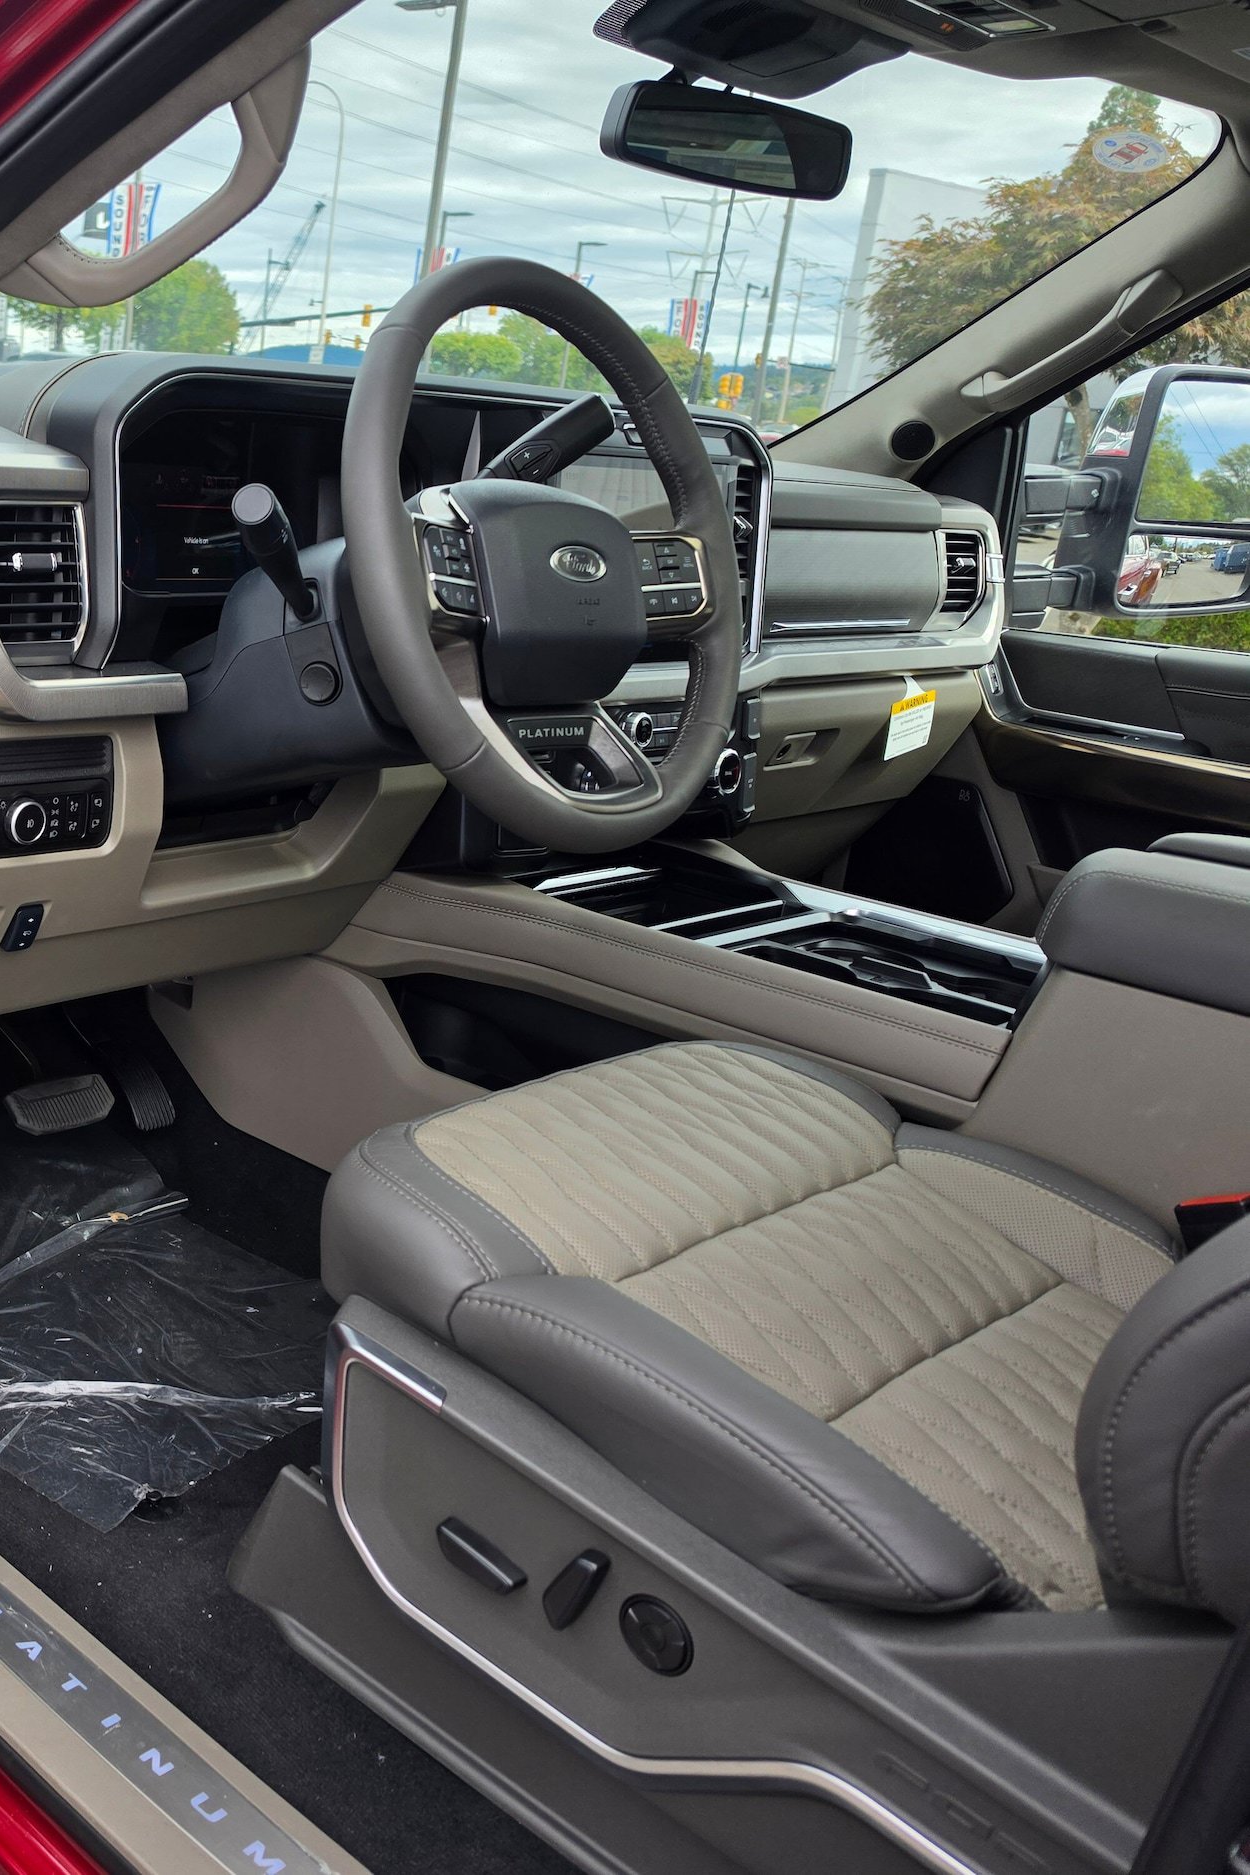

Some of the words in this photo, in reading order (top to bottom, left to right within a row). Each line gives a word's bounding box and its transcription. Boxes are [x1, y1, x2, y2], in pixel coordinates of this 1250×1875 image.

[112, 194, 125, 258] SOUND
[138, 194, 155, 247] FOR
[518, 726, 585, 739] PLATINUM
